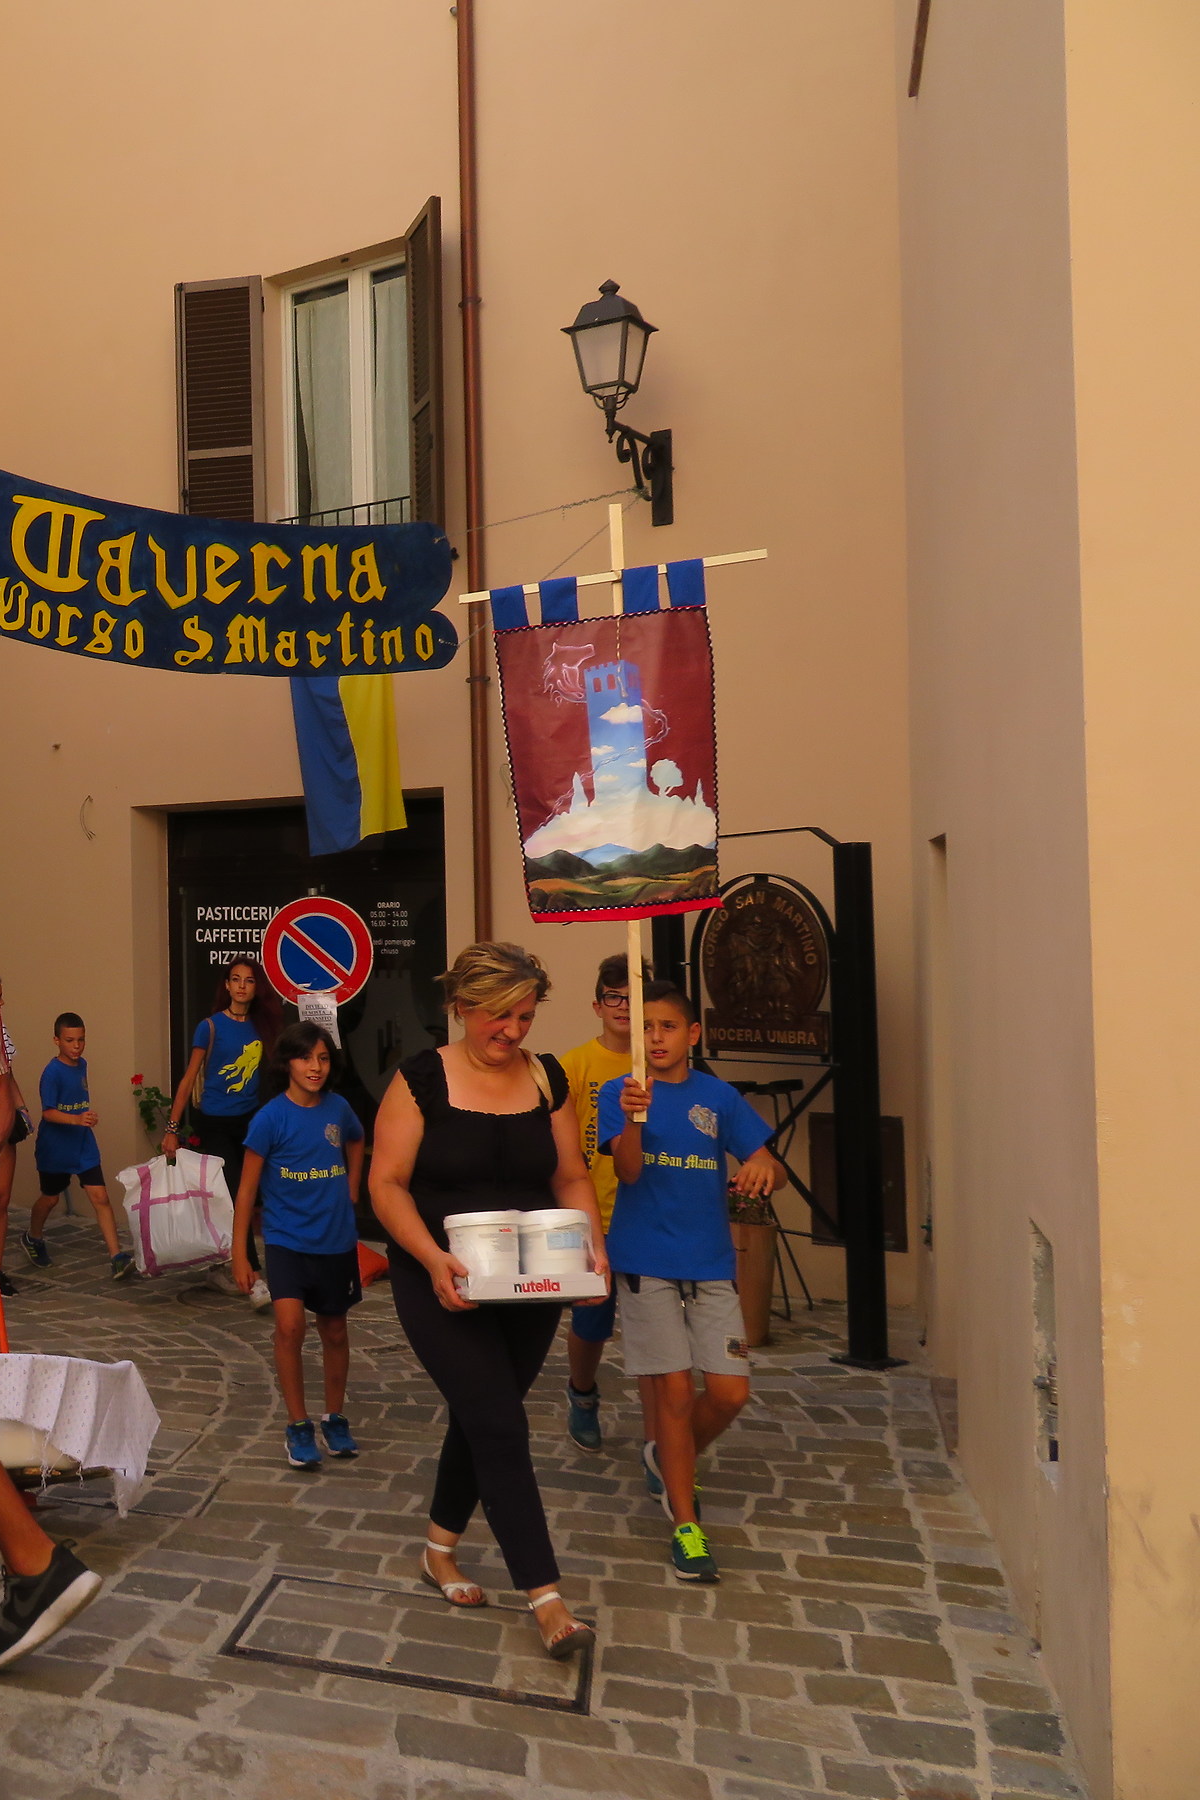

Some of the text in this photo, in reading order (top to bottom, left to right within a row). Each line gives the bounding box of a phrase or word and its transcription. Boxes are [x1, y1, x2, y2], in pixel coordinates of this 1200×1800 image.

[10, 494, 387, 610] Taverna
[377, 901, 401, 909] ORARIO
[392, 919, 409, 927] 21.00
[736, 891, 766, 910] SAN
[772, 896, 818, 966] MARTINO
[709, 1027, 818, 1046] NOCERA UMBRA
[658, 1151, 683, 1168] San
[280, 1166, 309, 1182] Borgo
[309, 1167, 329, 1180] San
[513, 1278, 561, 1293] nutella
